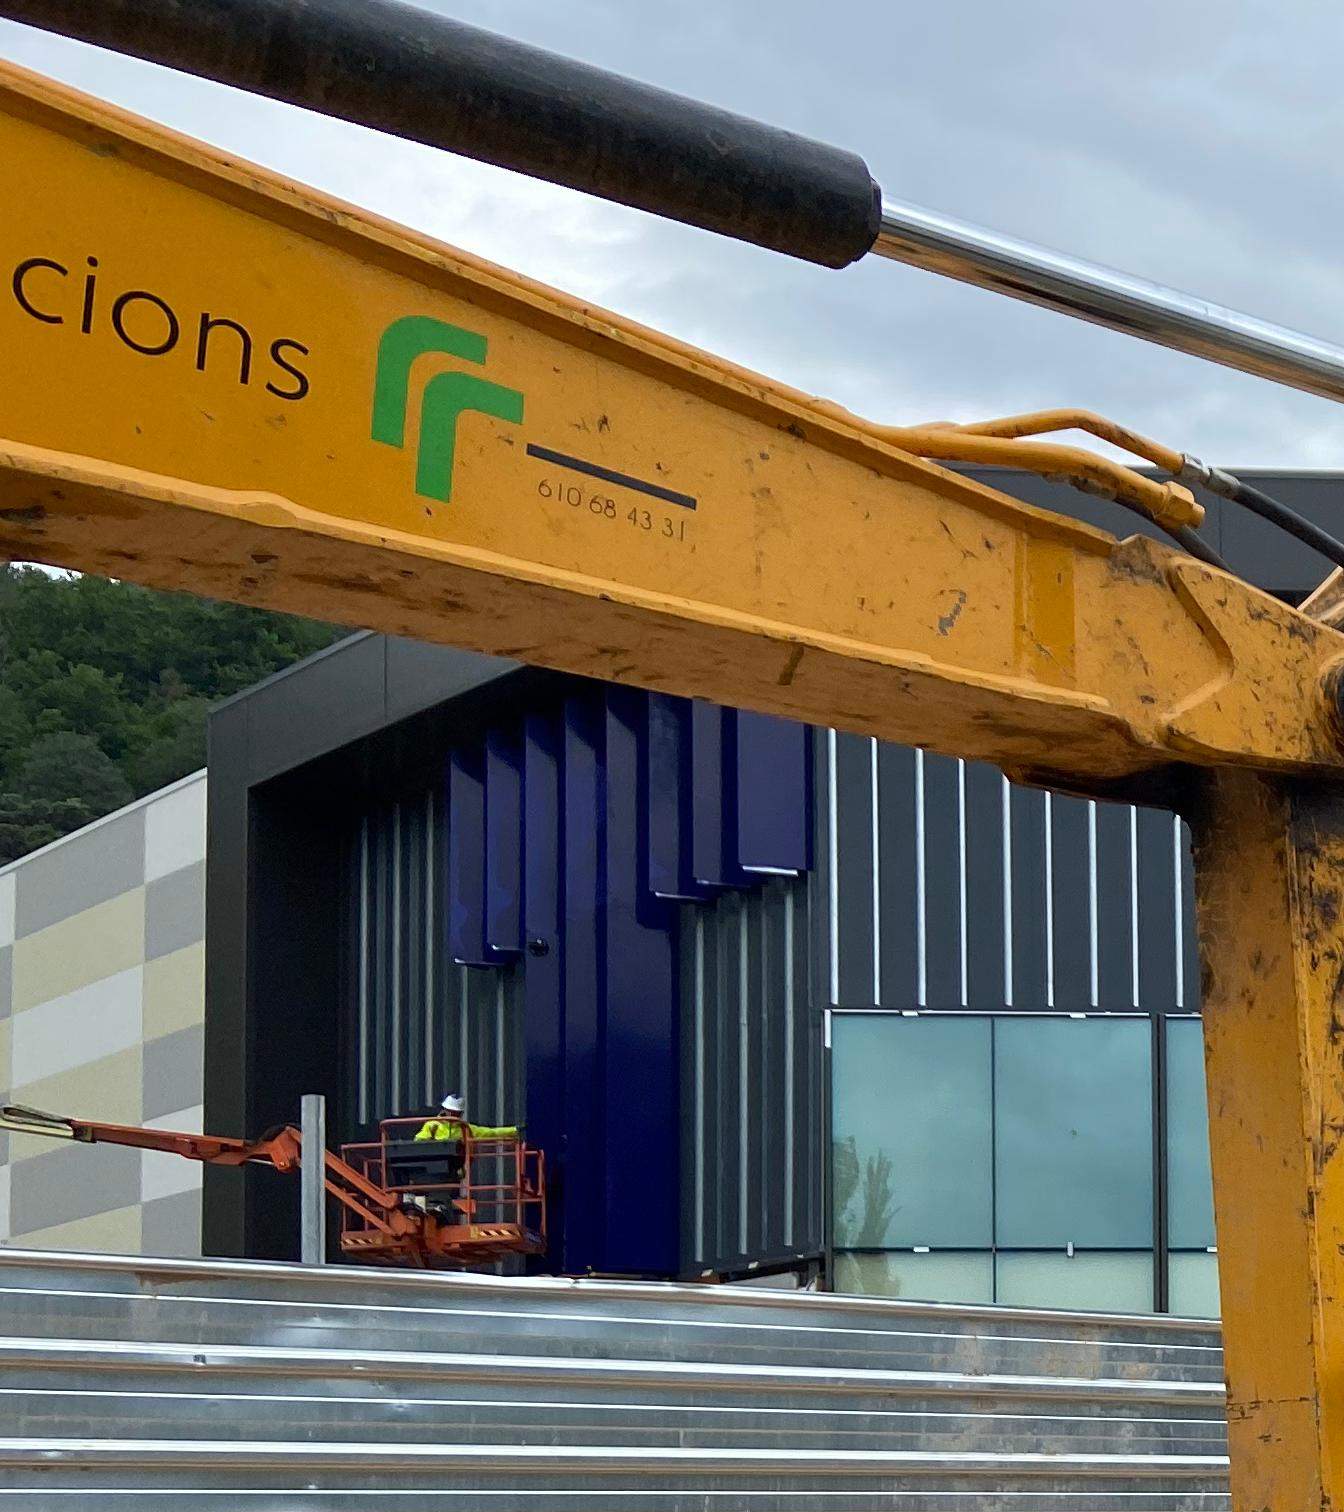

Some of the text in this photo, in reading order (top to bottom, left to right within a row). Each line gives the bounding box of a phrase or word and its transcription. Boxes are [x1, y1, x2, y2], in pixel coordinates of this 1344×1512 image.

[11, 254, 311, 401] cions
[537, 478, 686, 543] 610 68 43 31
